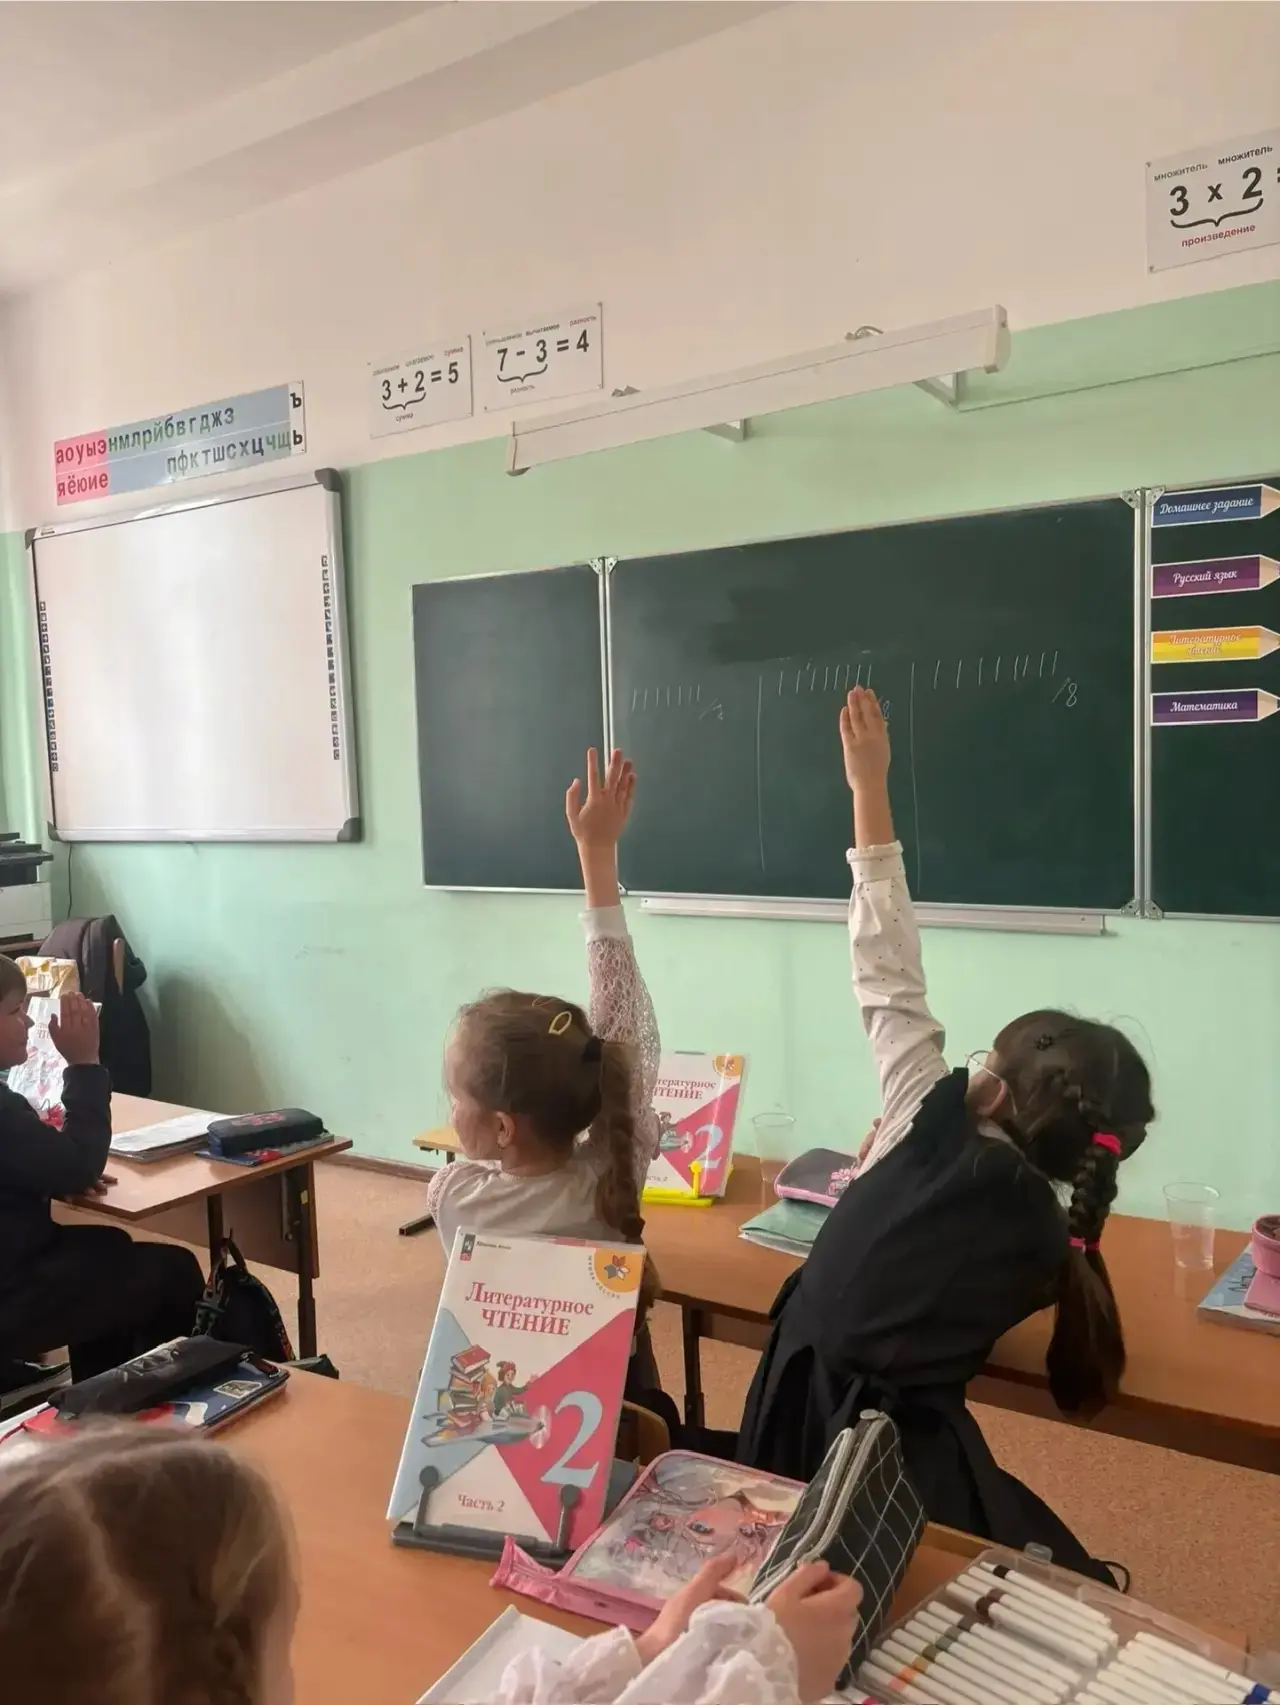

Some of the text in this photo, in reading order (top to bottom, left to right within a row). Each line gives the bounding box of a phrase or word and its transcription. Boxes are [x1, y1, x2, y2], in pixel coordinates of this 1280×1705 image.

[1154, 145, 1273, 181] множитель множитель
[1169, 185, 1189, 216] 3
[1242, 167, 1262, 200] 2
[1181, 224, 1256, 248] произведение
[497, 348, 508, 371] 7
[536, 339, 547, 363] 3
[557, 339, 569, 352] =
[576, 329, 589, 352] 4
[382, 361, 459, 401] 3 + 2 = 5
[57, 472, 109, 497] яёюие
[1160, 498, 1254, 514] Домашнее задание
[1173, 570, 1237, 587] Русский язык
[1170, 701, 1238, 712] Математика
[657, 1079, 716, 1090] тературное
[695, 1124, 723, 1169] 2
[465, 1281, 594, 1316] Литературное
[481, 1308, 571, 1336] ЧТЕНИЕ
[540, 1390, 604, 1489] 2
[458, 1493, 505, 1512] Часть 2
